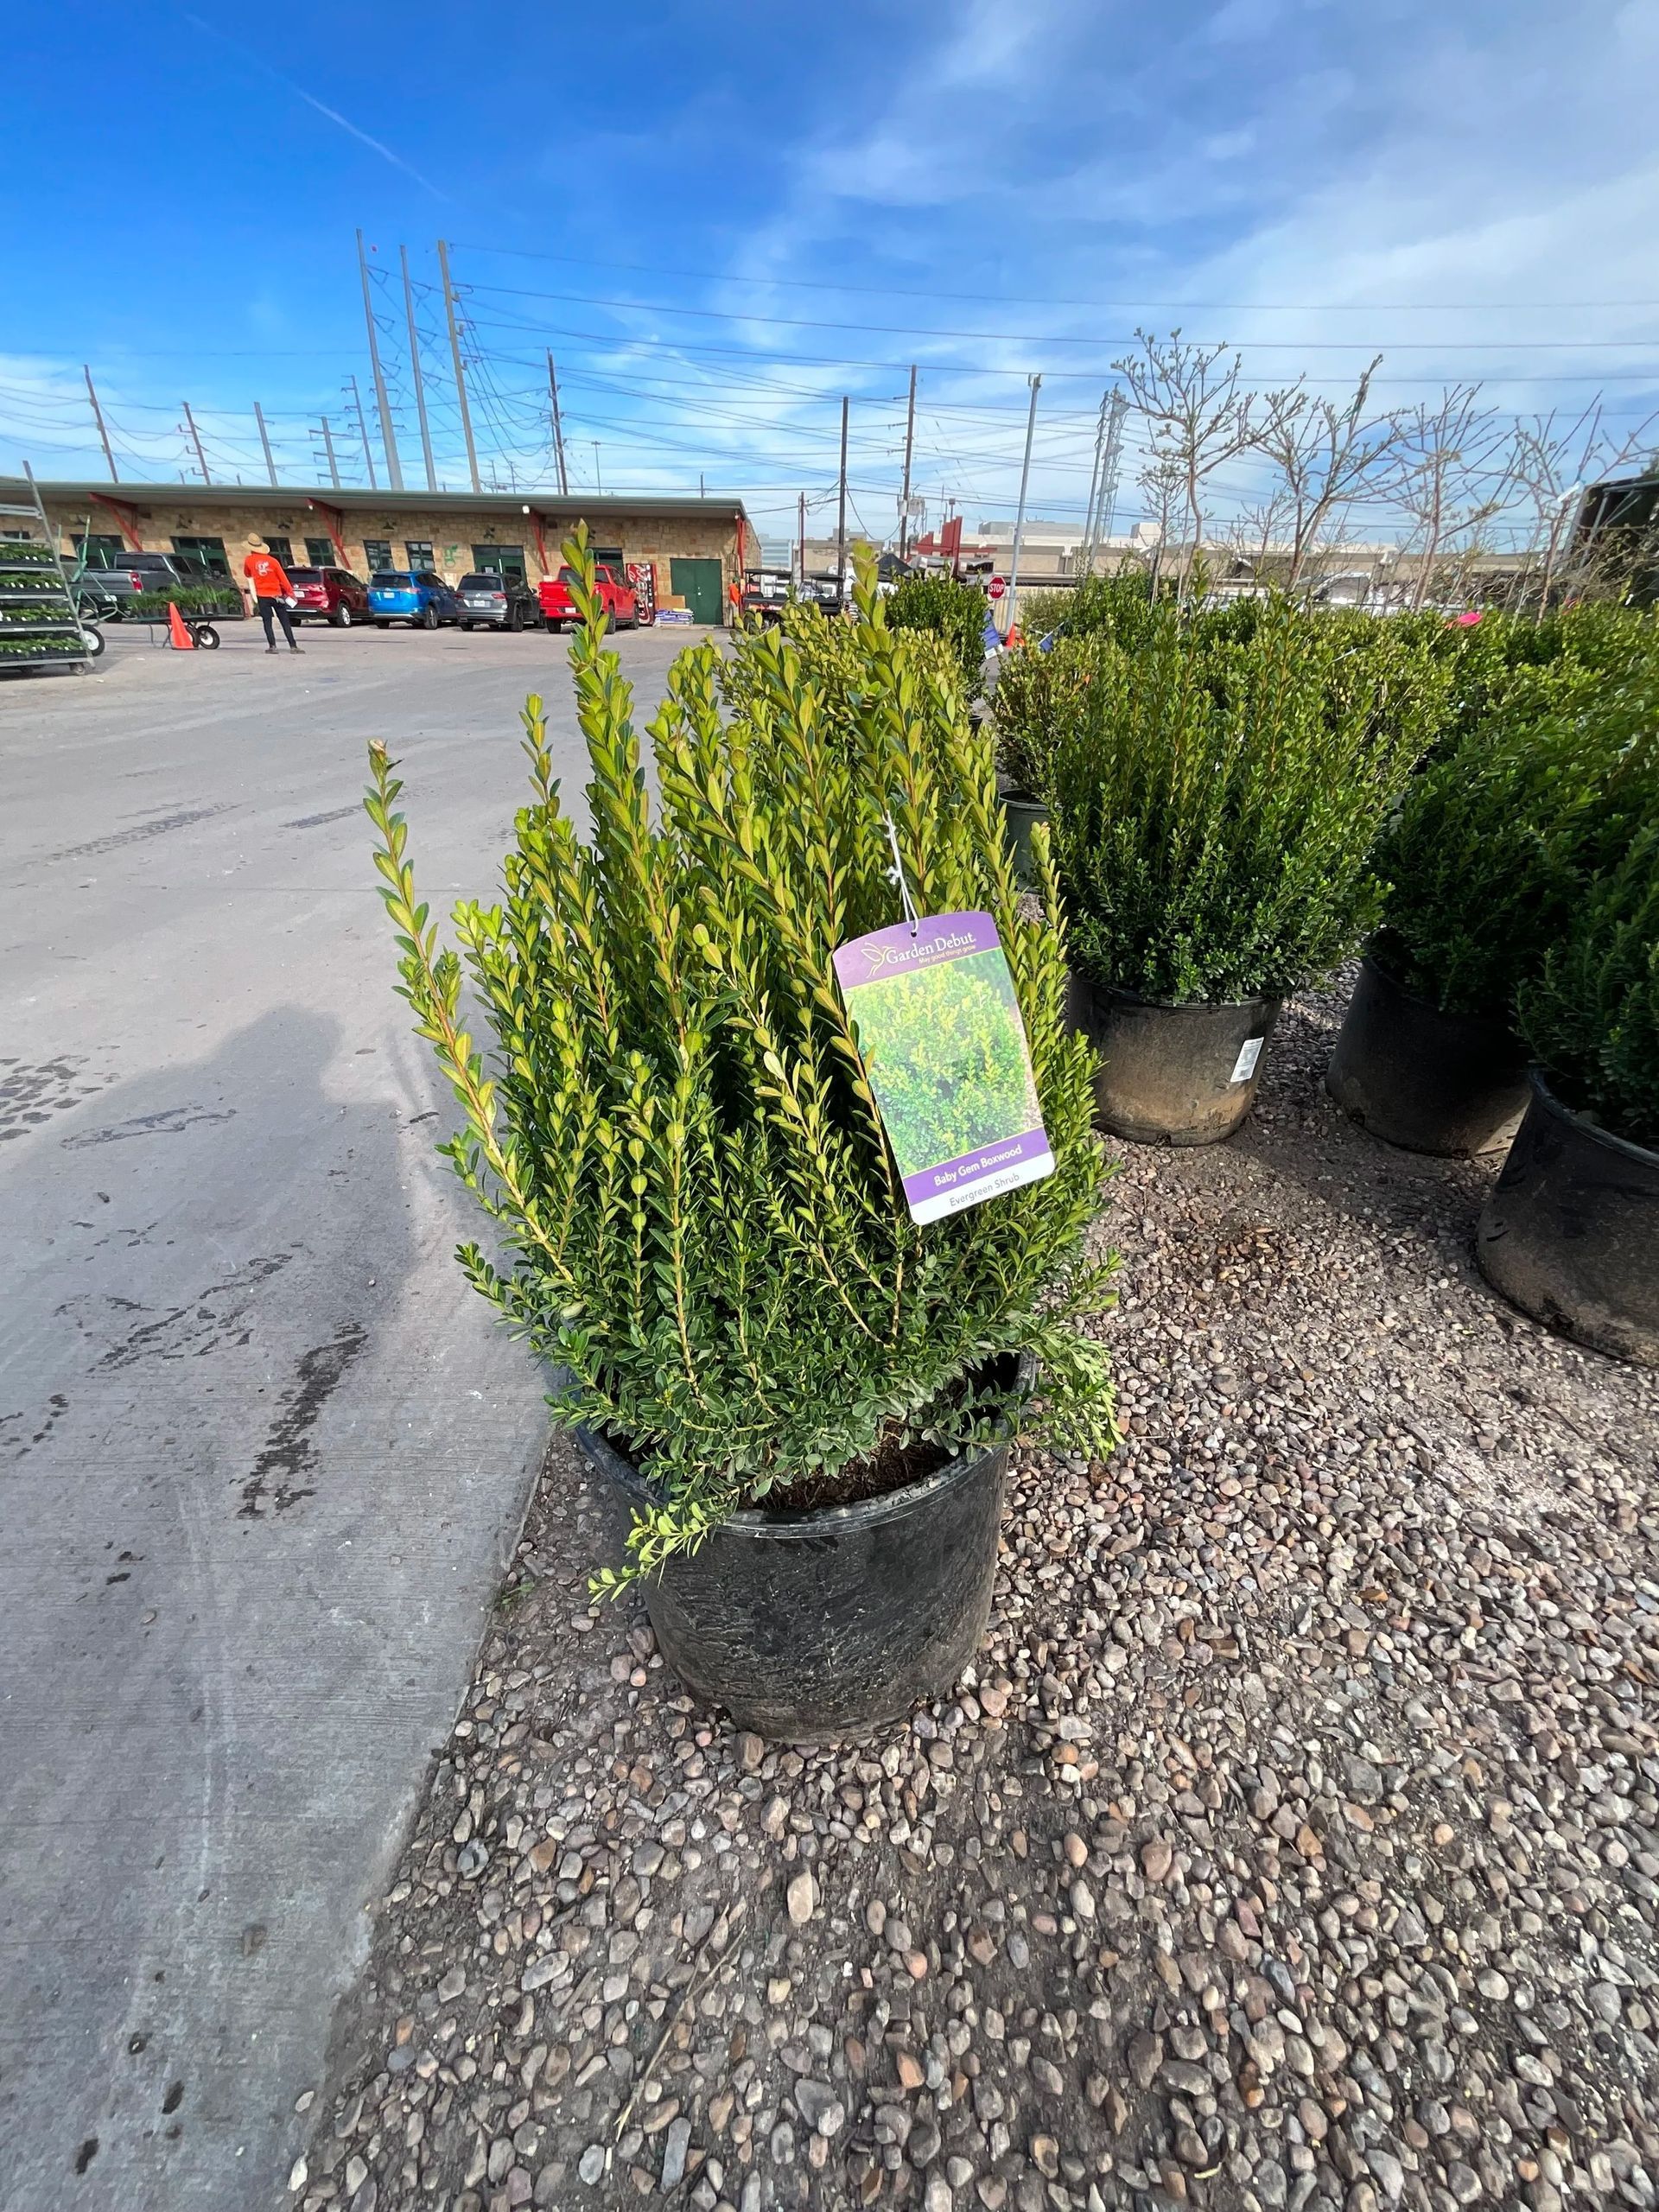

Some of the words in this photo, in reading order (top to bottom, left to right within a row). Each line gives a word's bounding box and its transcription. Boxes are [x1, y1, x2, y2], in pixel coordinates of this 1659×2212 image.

[989, 583, 1004, 593] STOP
[886, 944, 933, 963] Garden
[931, 952, 945, 962] good
[933, 1172, 957, 1187] Baby
[957, 1162, 981, 1176] Gem
[980, 1144, 1022, 1168] Boxwood
[949, 1185, 994, 1206] Evergreen
[994, 1173, 1020, 1189] Shrub
